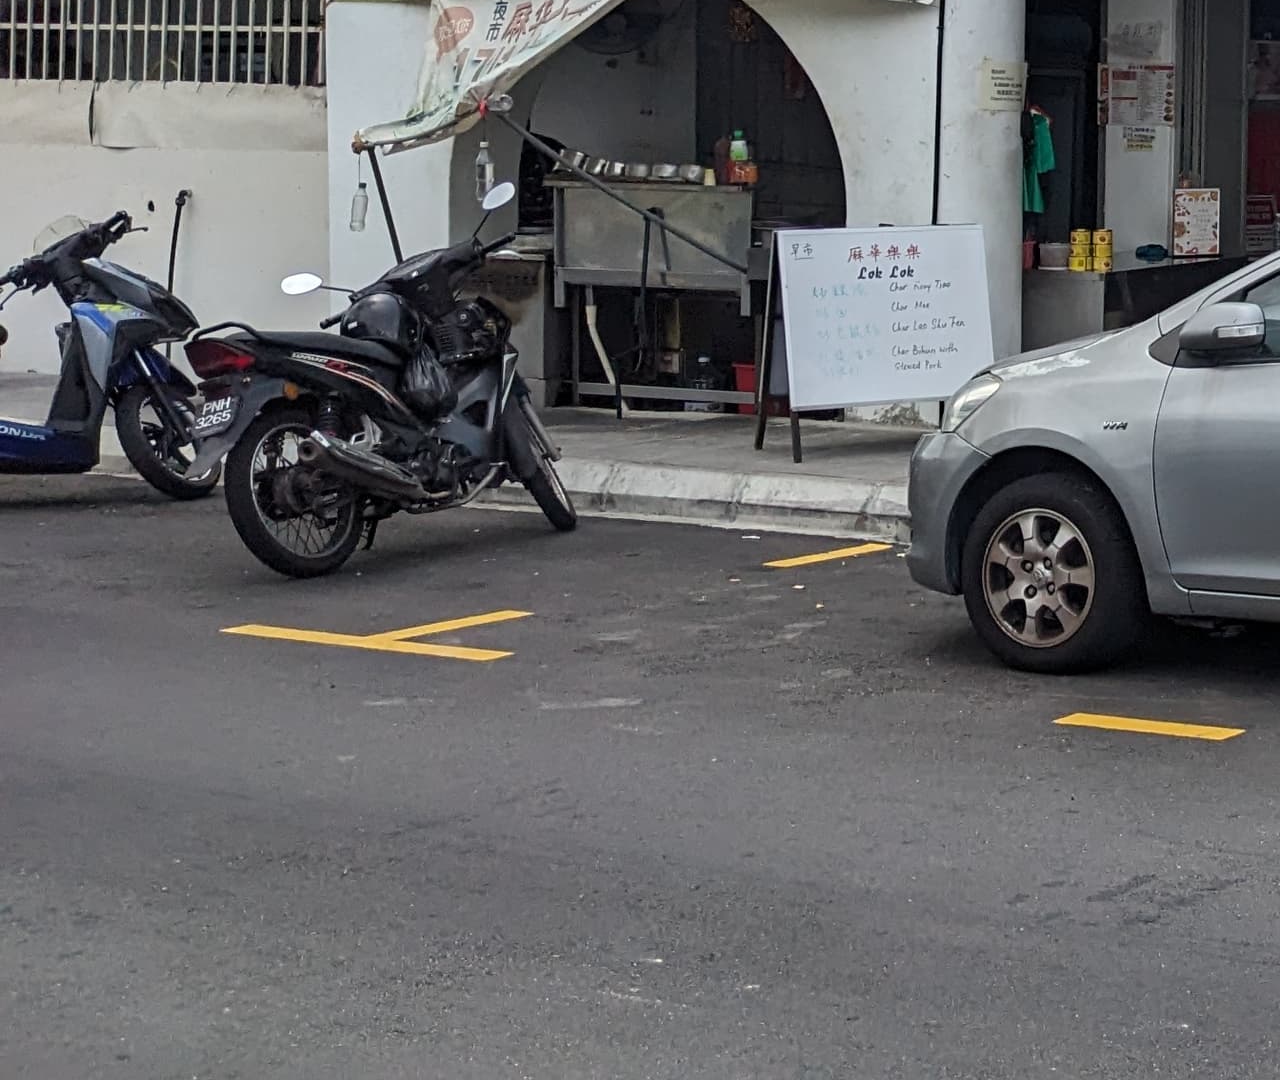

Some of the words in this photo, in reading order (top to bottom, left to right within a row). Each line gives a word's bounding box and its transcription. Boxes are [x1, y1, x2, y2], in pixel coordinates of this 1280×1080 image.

[485, 0, 508, 42] 夜市
[857, 266, 883, 280] Lok
[889, 264, 915, 279] Lok
[925, 359, 943, 370] Pork
[202, 396, 231, 416] PNH
[195, 409, 232, 429] 3265
[0, 425, 46, 440] ONDA
